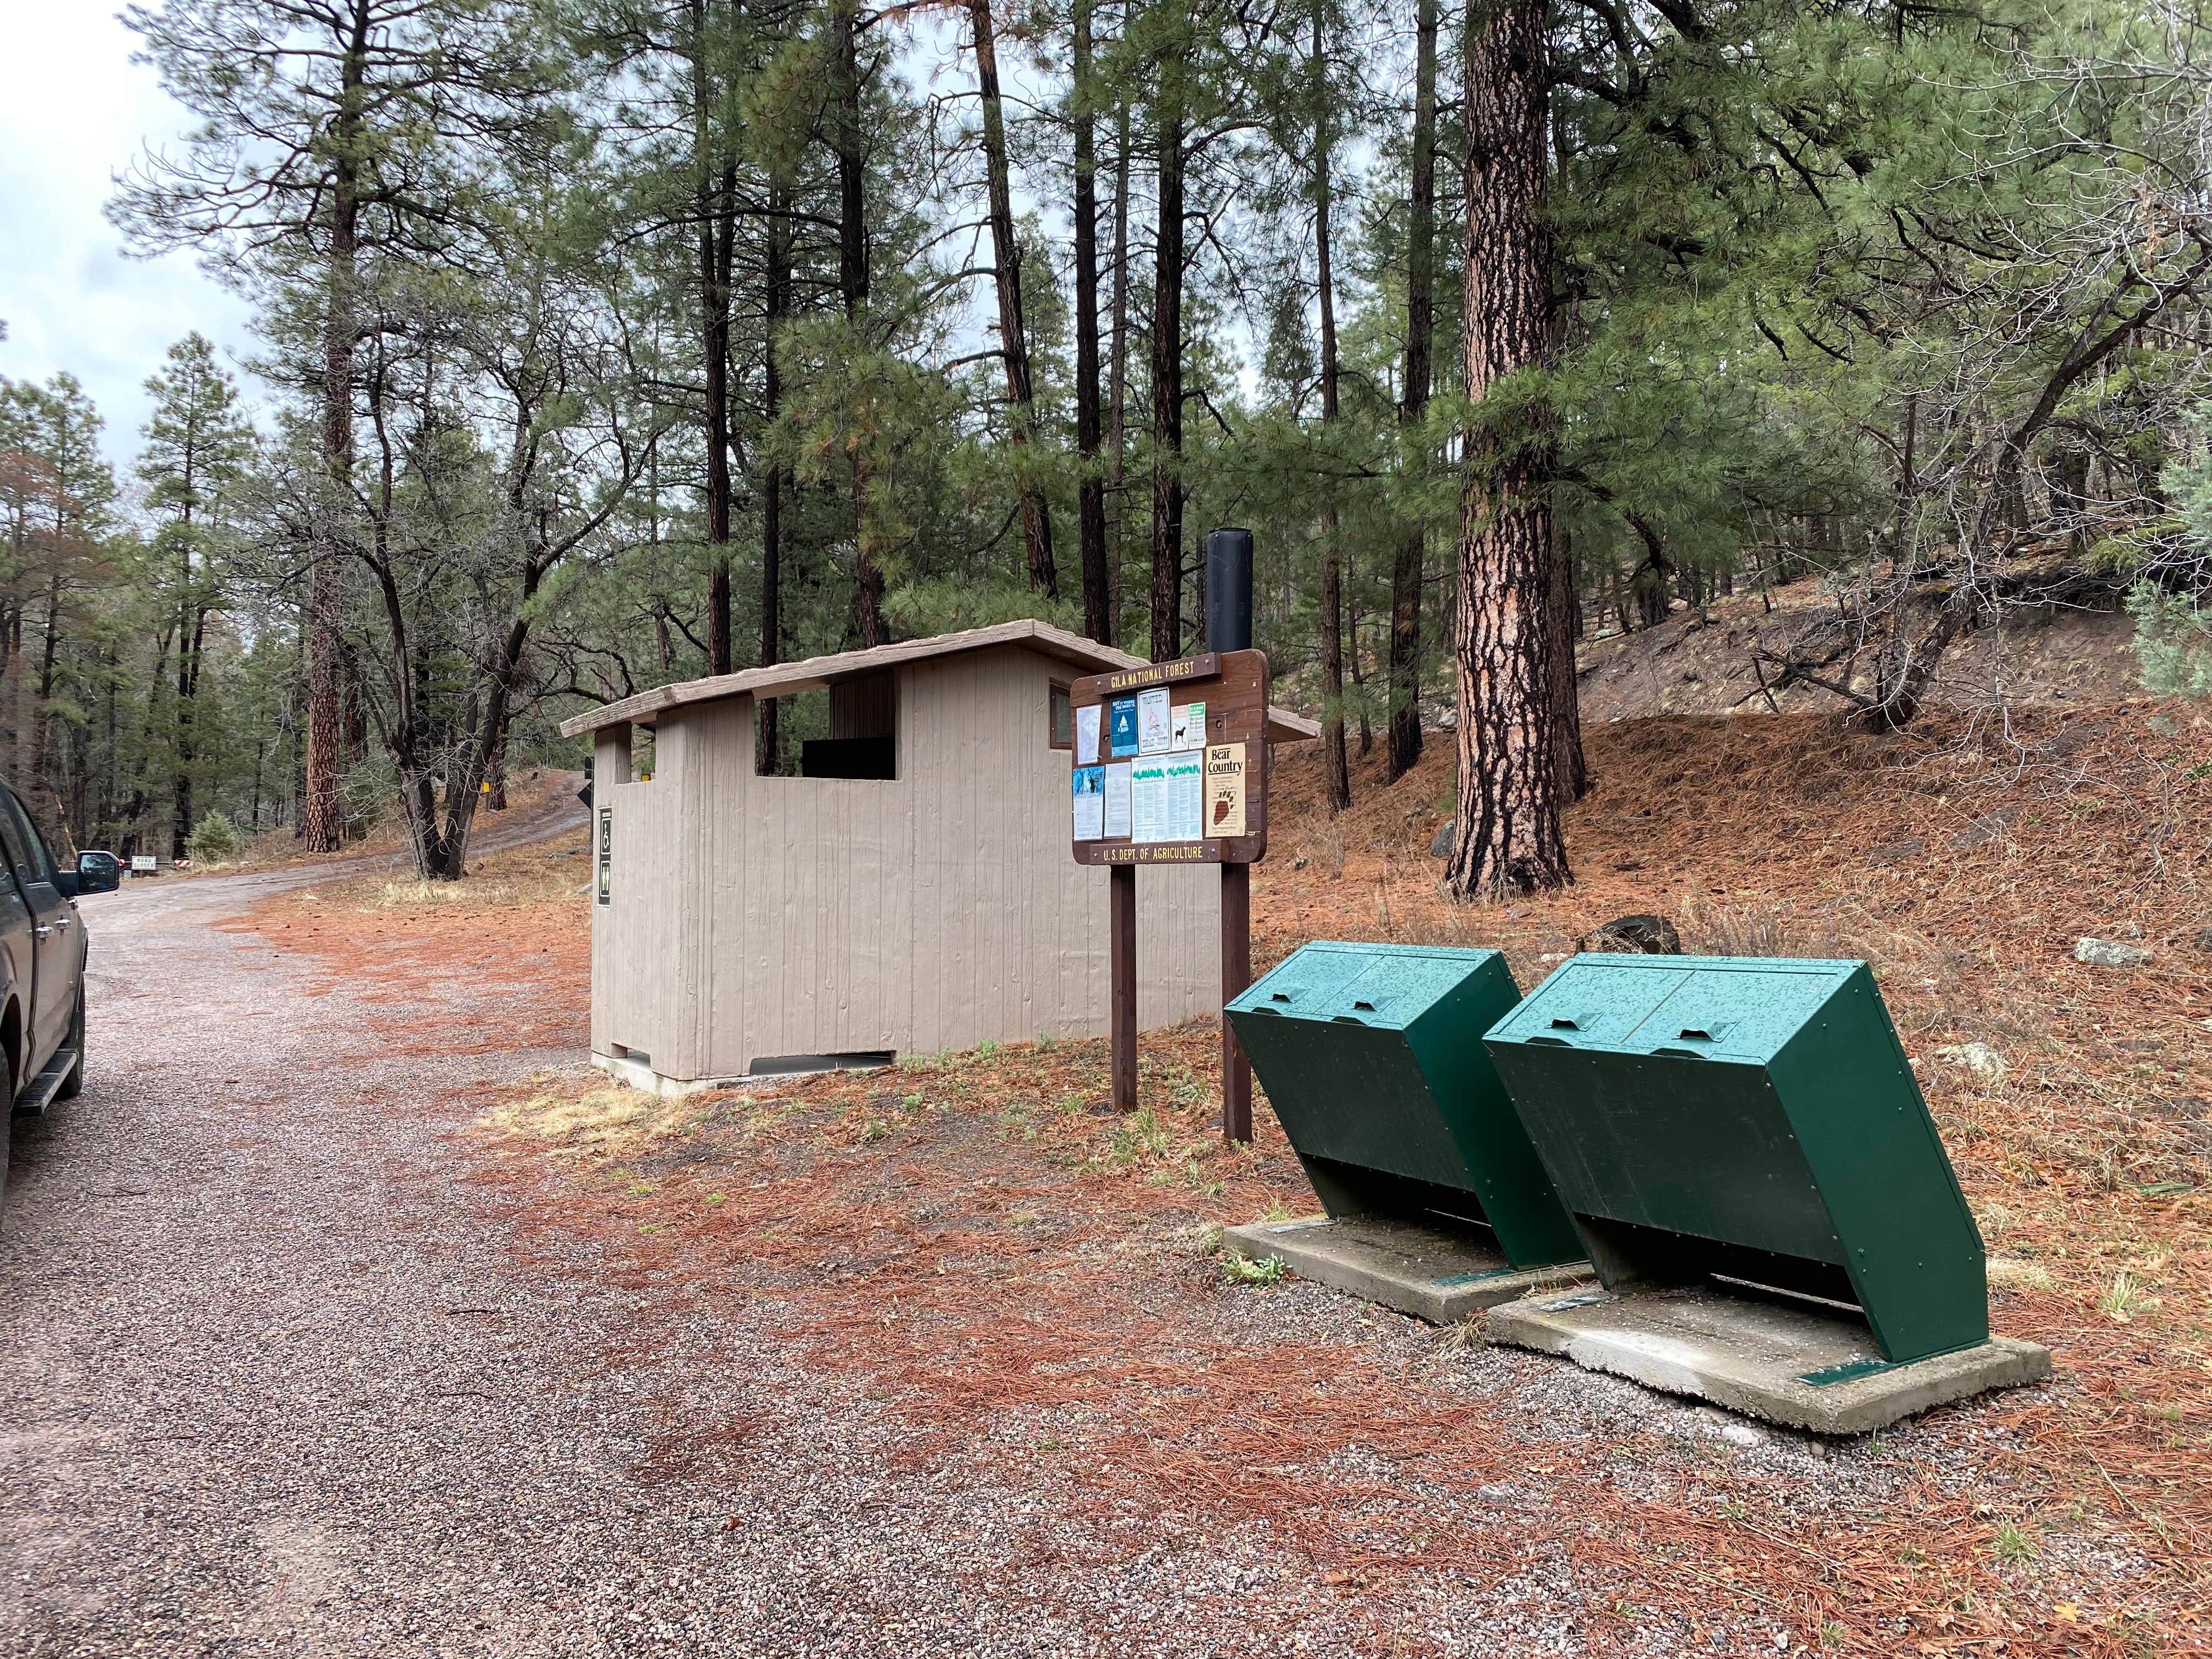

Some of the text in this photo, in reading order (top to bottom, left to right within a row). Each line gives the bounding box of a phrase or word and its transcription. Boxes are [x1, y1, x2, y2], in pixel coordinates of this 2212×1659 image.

[1111, 661, 1194, 688] GILA NATIONAL FOREST
[1142, 694, 1163, 705] WANTED
[1212, 749, 1231, 760] Bear
[1208, 760, 1243, 776] Country
[1119, 849, 1138, 861] DEPT.
[1140, 848, 1149, 860] OF
[1153, 847, 1203, 860] AGRICULTURE
